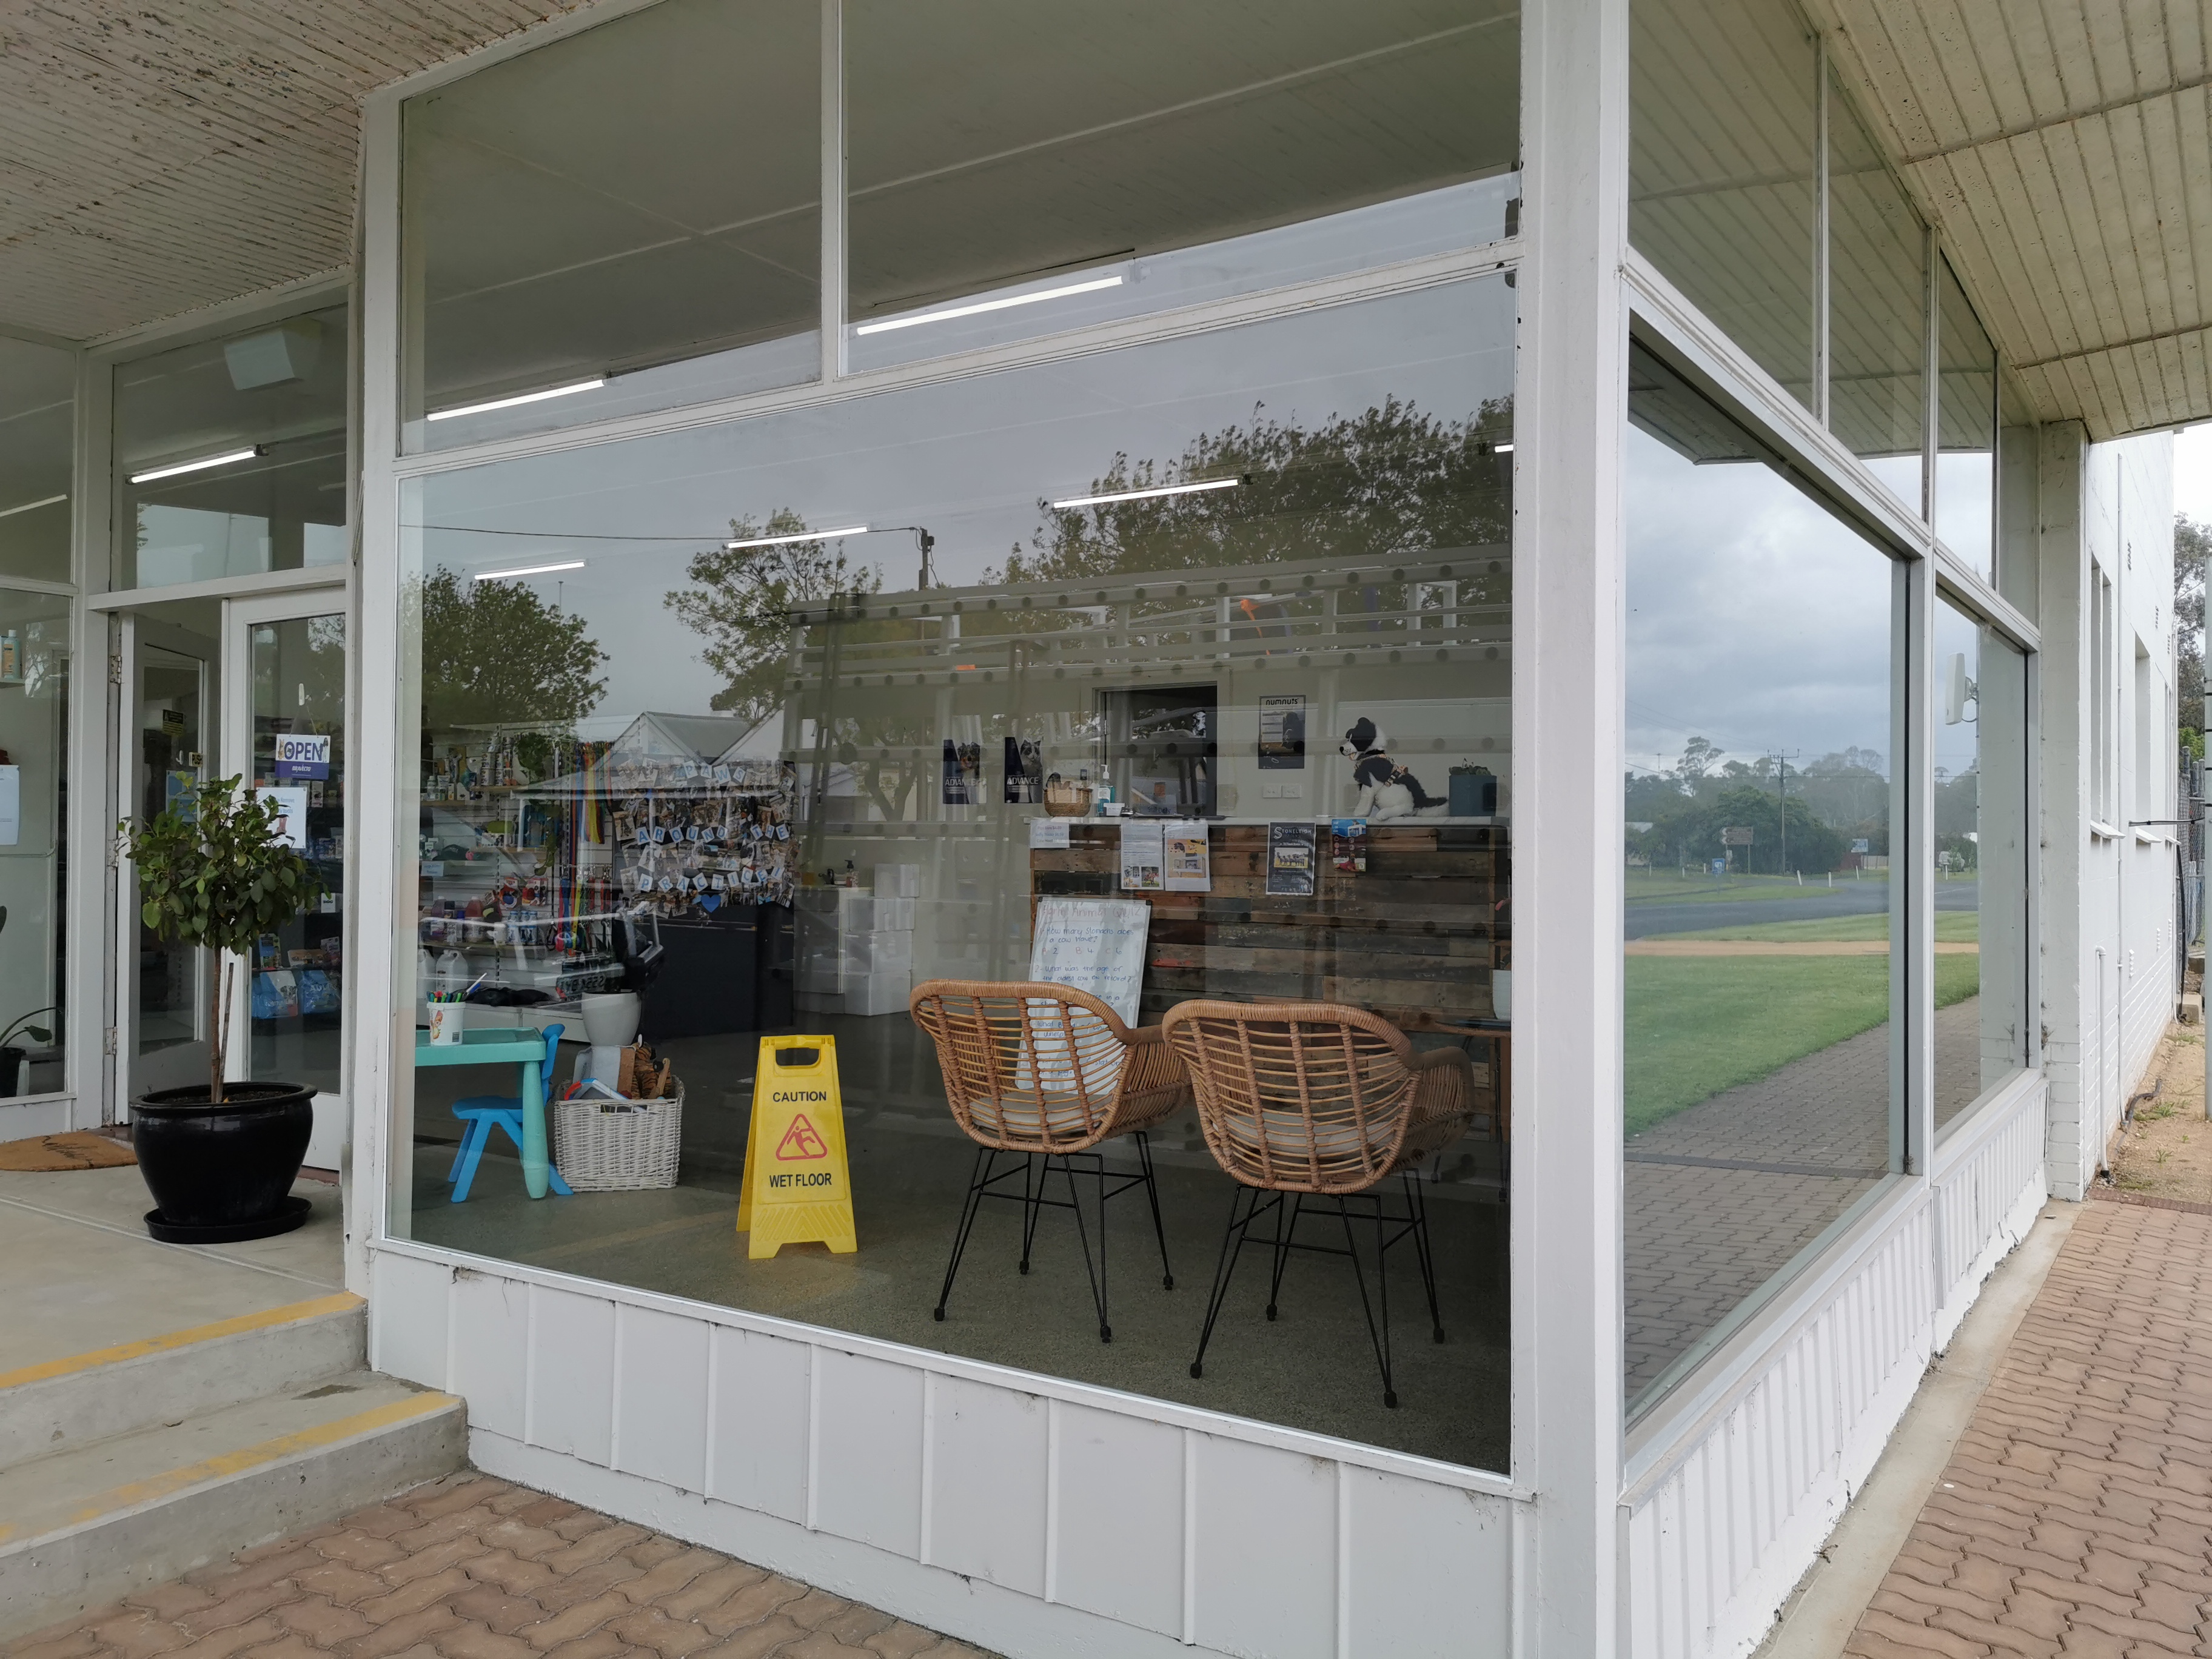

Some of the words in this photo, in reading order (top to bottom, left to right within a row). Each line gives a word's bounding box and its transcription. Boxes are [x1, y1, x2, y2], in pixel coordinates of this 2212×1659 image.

[283, 741, 324, 762] OPEN
[685, 765, 743, 781] PAWS
[1007, 777, 1040, 785] ADVANCE
[638, 826, 726, 843] AROUND
[752, 825, 786, 839] THE
[1273, 826, 1312, 840] STONELEIGH
[1047, 927, 1061, 936] How
[1064, 928, 1083, 937] many
[773, 1091, 827, 1102] CAUTION
[769, 1174, 793, 1188] WET
[796, 1173, 833, 1187] FLOOR
